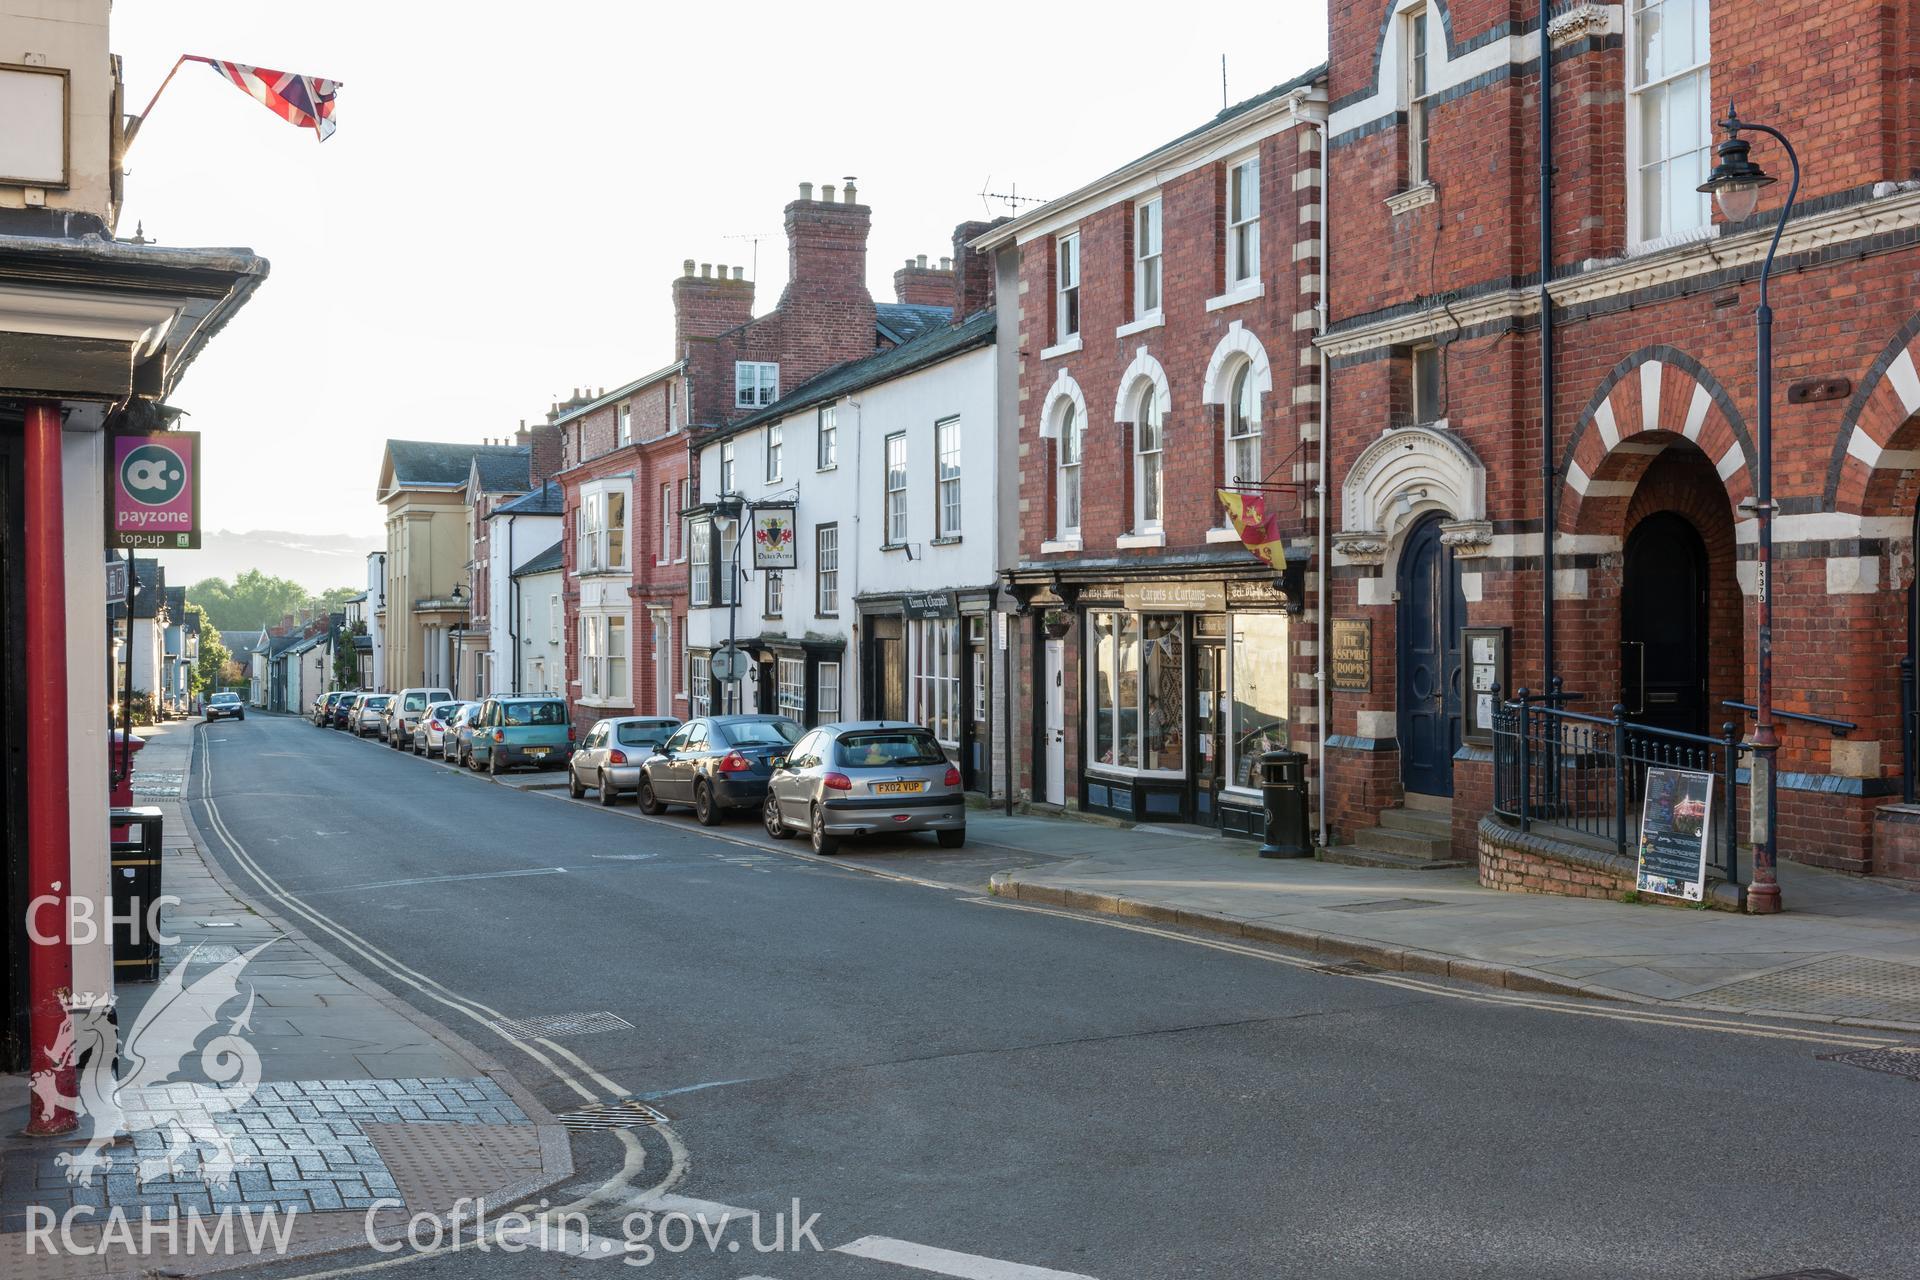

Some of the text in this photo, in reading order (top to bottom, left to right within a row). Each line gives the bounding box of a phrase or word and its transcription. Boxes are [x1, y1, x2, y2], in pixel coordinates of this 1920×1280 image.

[119, 510, 189, 526] payzone
[120, 533, 165, 547] top-up
[1140, 586, 1166, 603] Carpets
[1175, 586, 1206, 601] Curtains
[1333, 648, 1369, 660] ASSEMBLY
[1337, 662, 1364, 674] ROOMS
[878, 782, 920, 792] FX02 VUP
